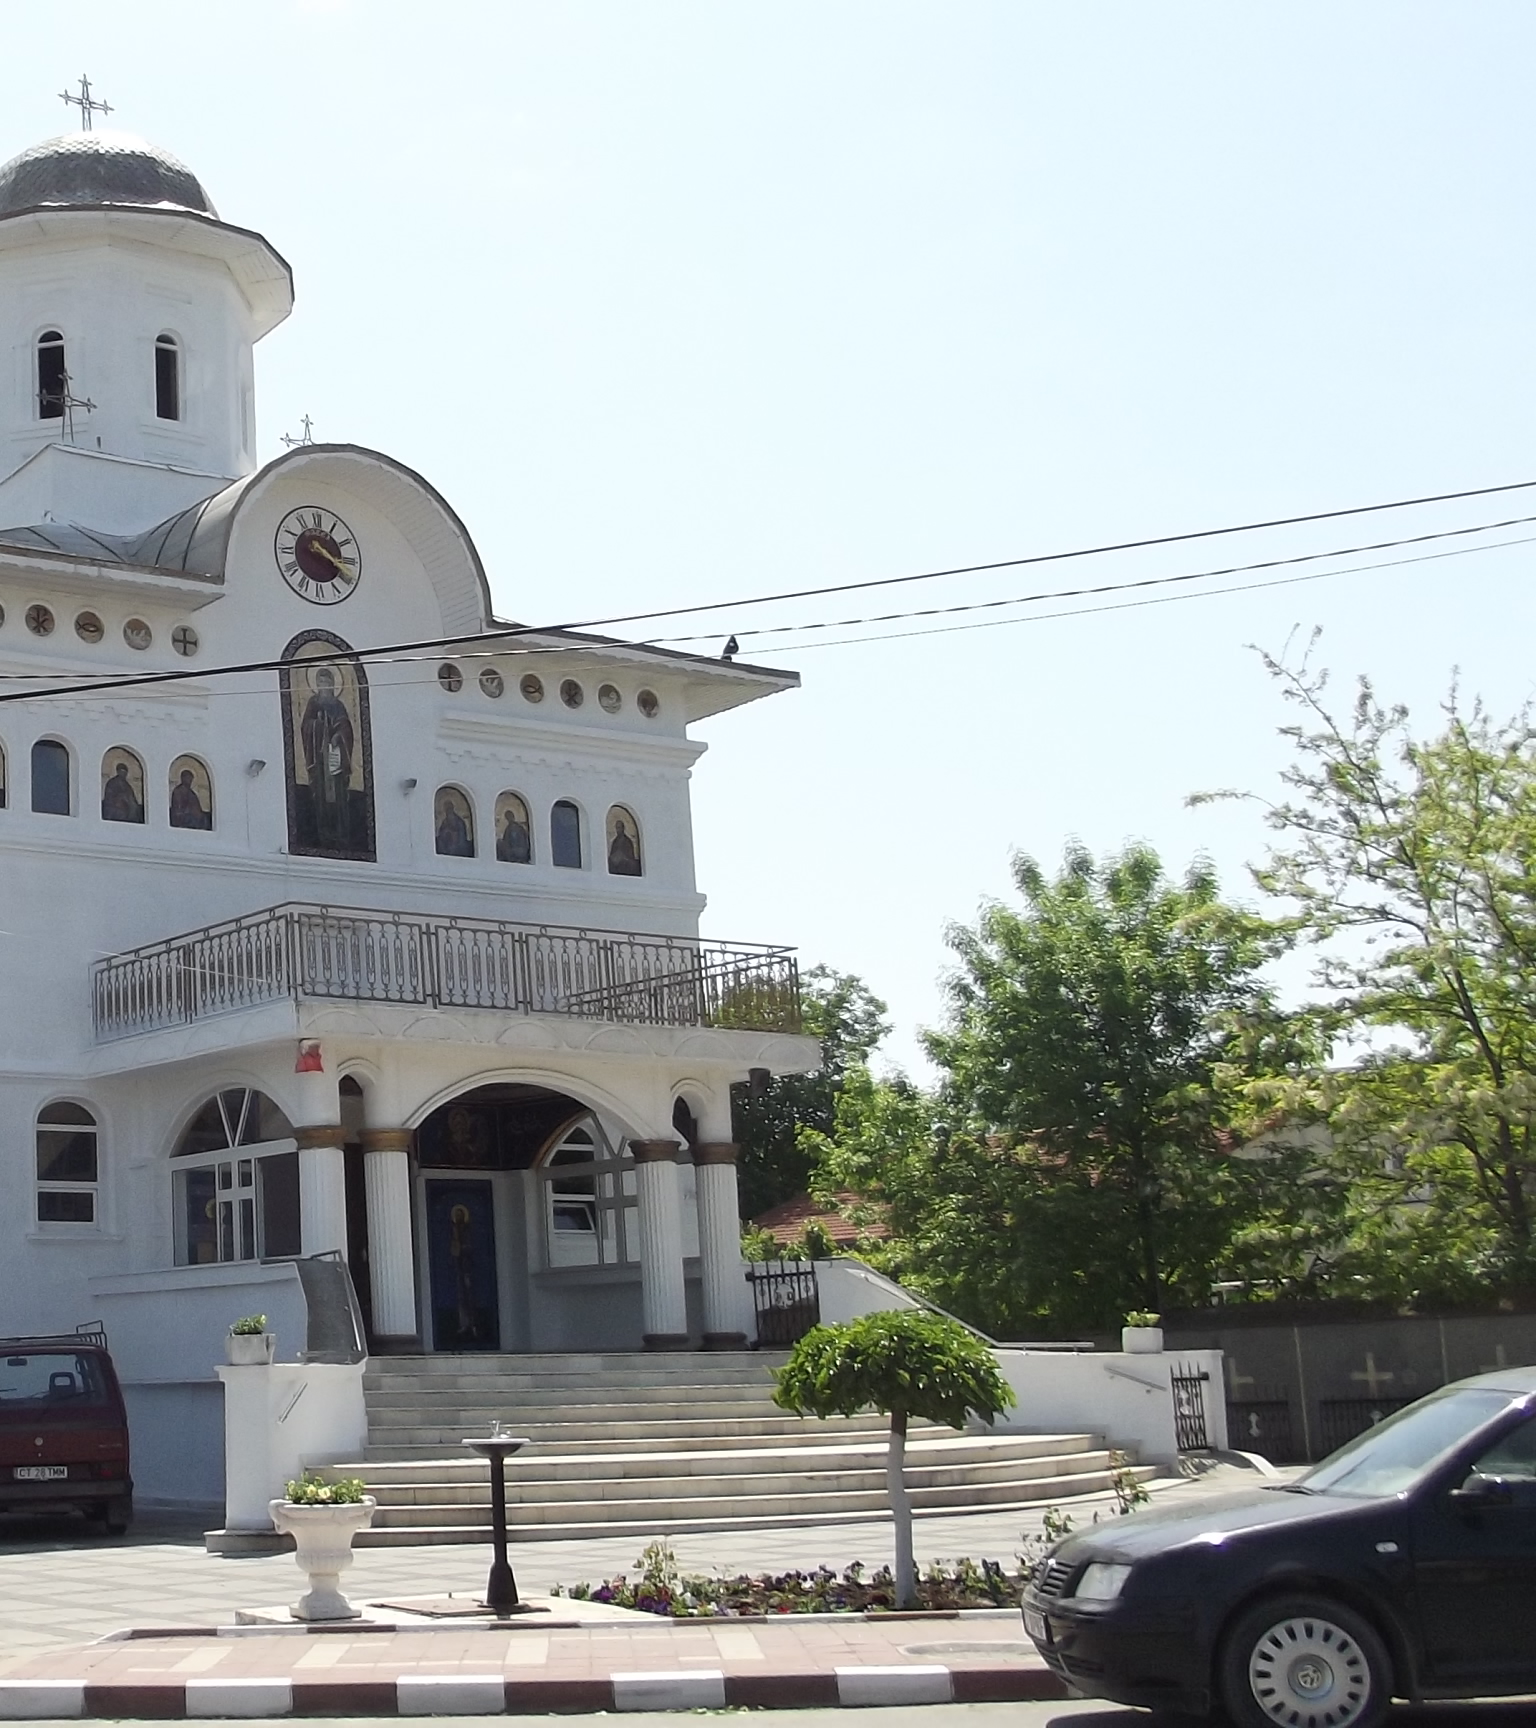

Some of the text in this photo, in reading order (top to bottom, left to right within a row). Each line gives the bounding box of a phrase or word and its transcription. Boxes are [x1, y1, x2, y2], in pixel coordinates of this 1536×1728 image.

[19, 1467, 65, 1478] CT 28 TMM
